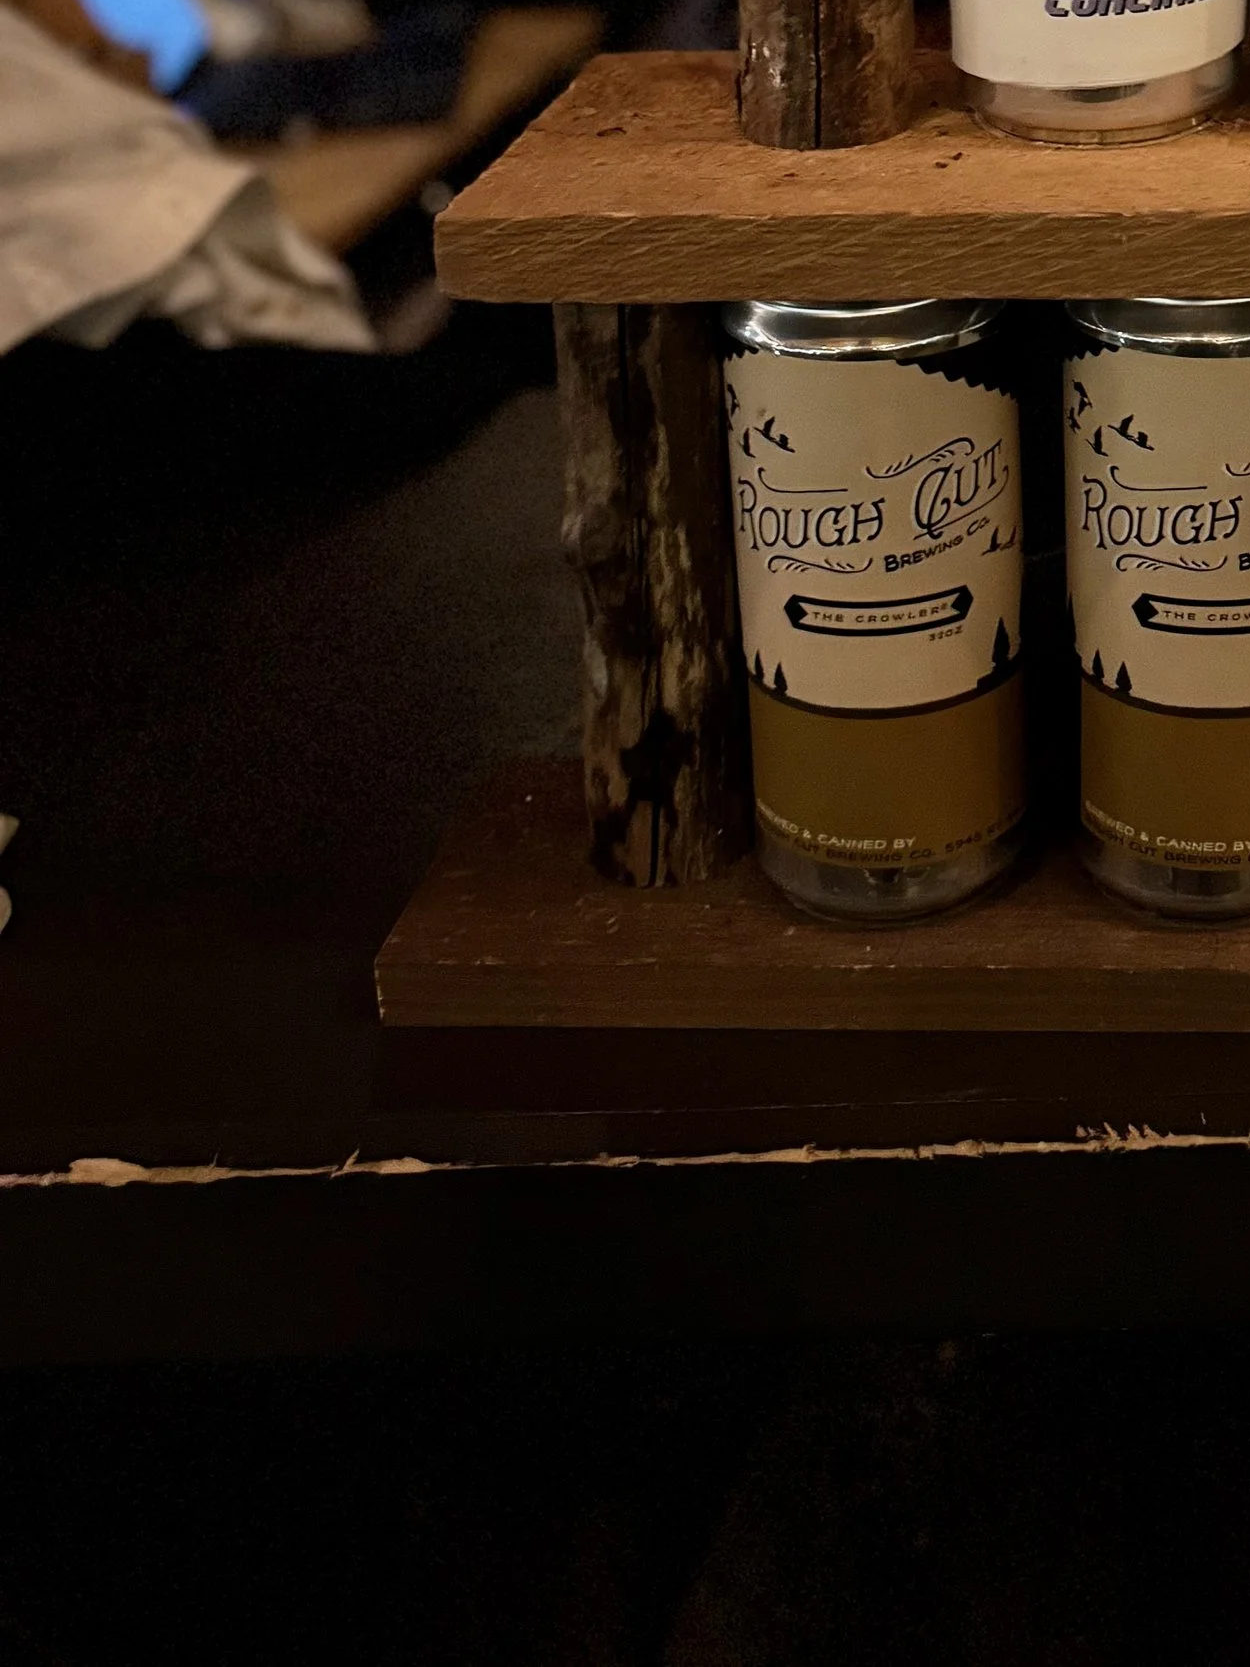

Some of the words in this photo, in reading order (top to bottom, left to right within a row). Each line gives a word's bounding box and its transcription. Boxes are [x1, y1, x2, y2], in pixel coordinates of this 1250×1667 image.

[738, 477, 885, 551] ROUGH
[1082, 475, 1243, 550] ROUGH
[884, 535, 963, 573] BREWING
[812, 611, 844, 623] THE
[1162, 610, 1196, 621] THE
[817, 834, 887, 850] CANNED
[893, 837, 916, 849] BY
[1156, 835, 1227, 852] CANNED
[1164, 850, 1242, 865] BREWING
